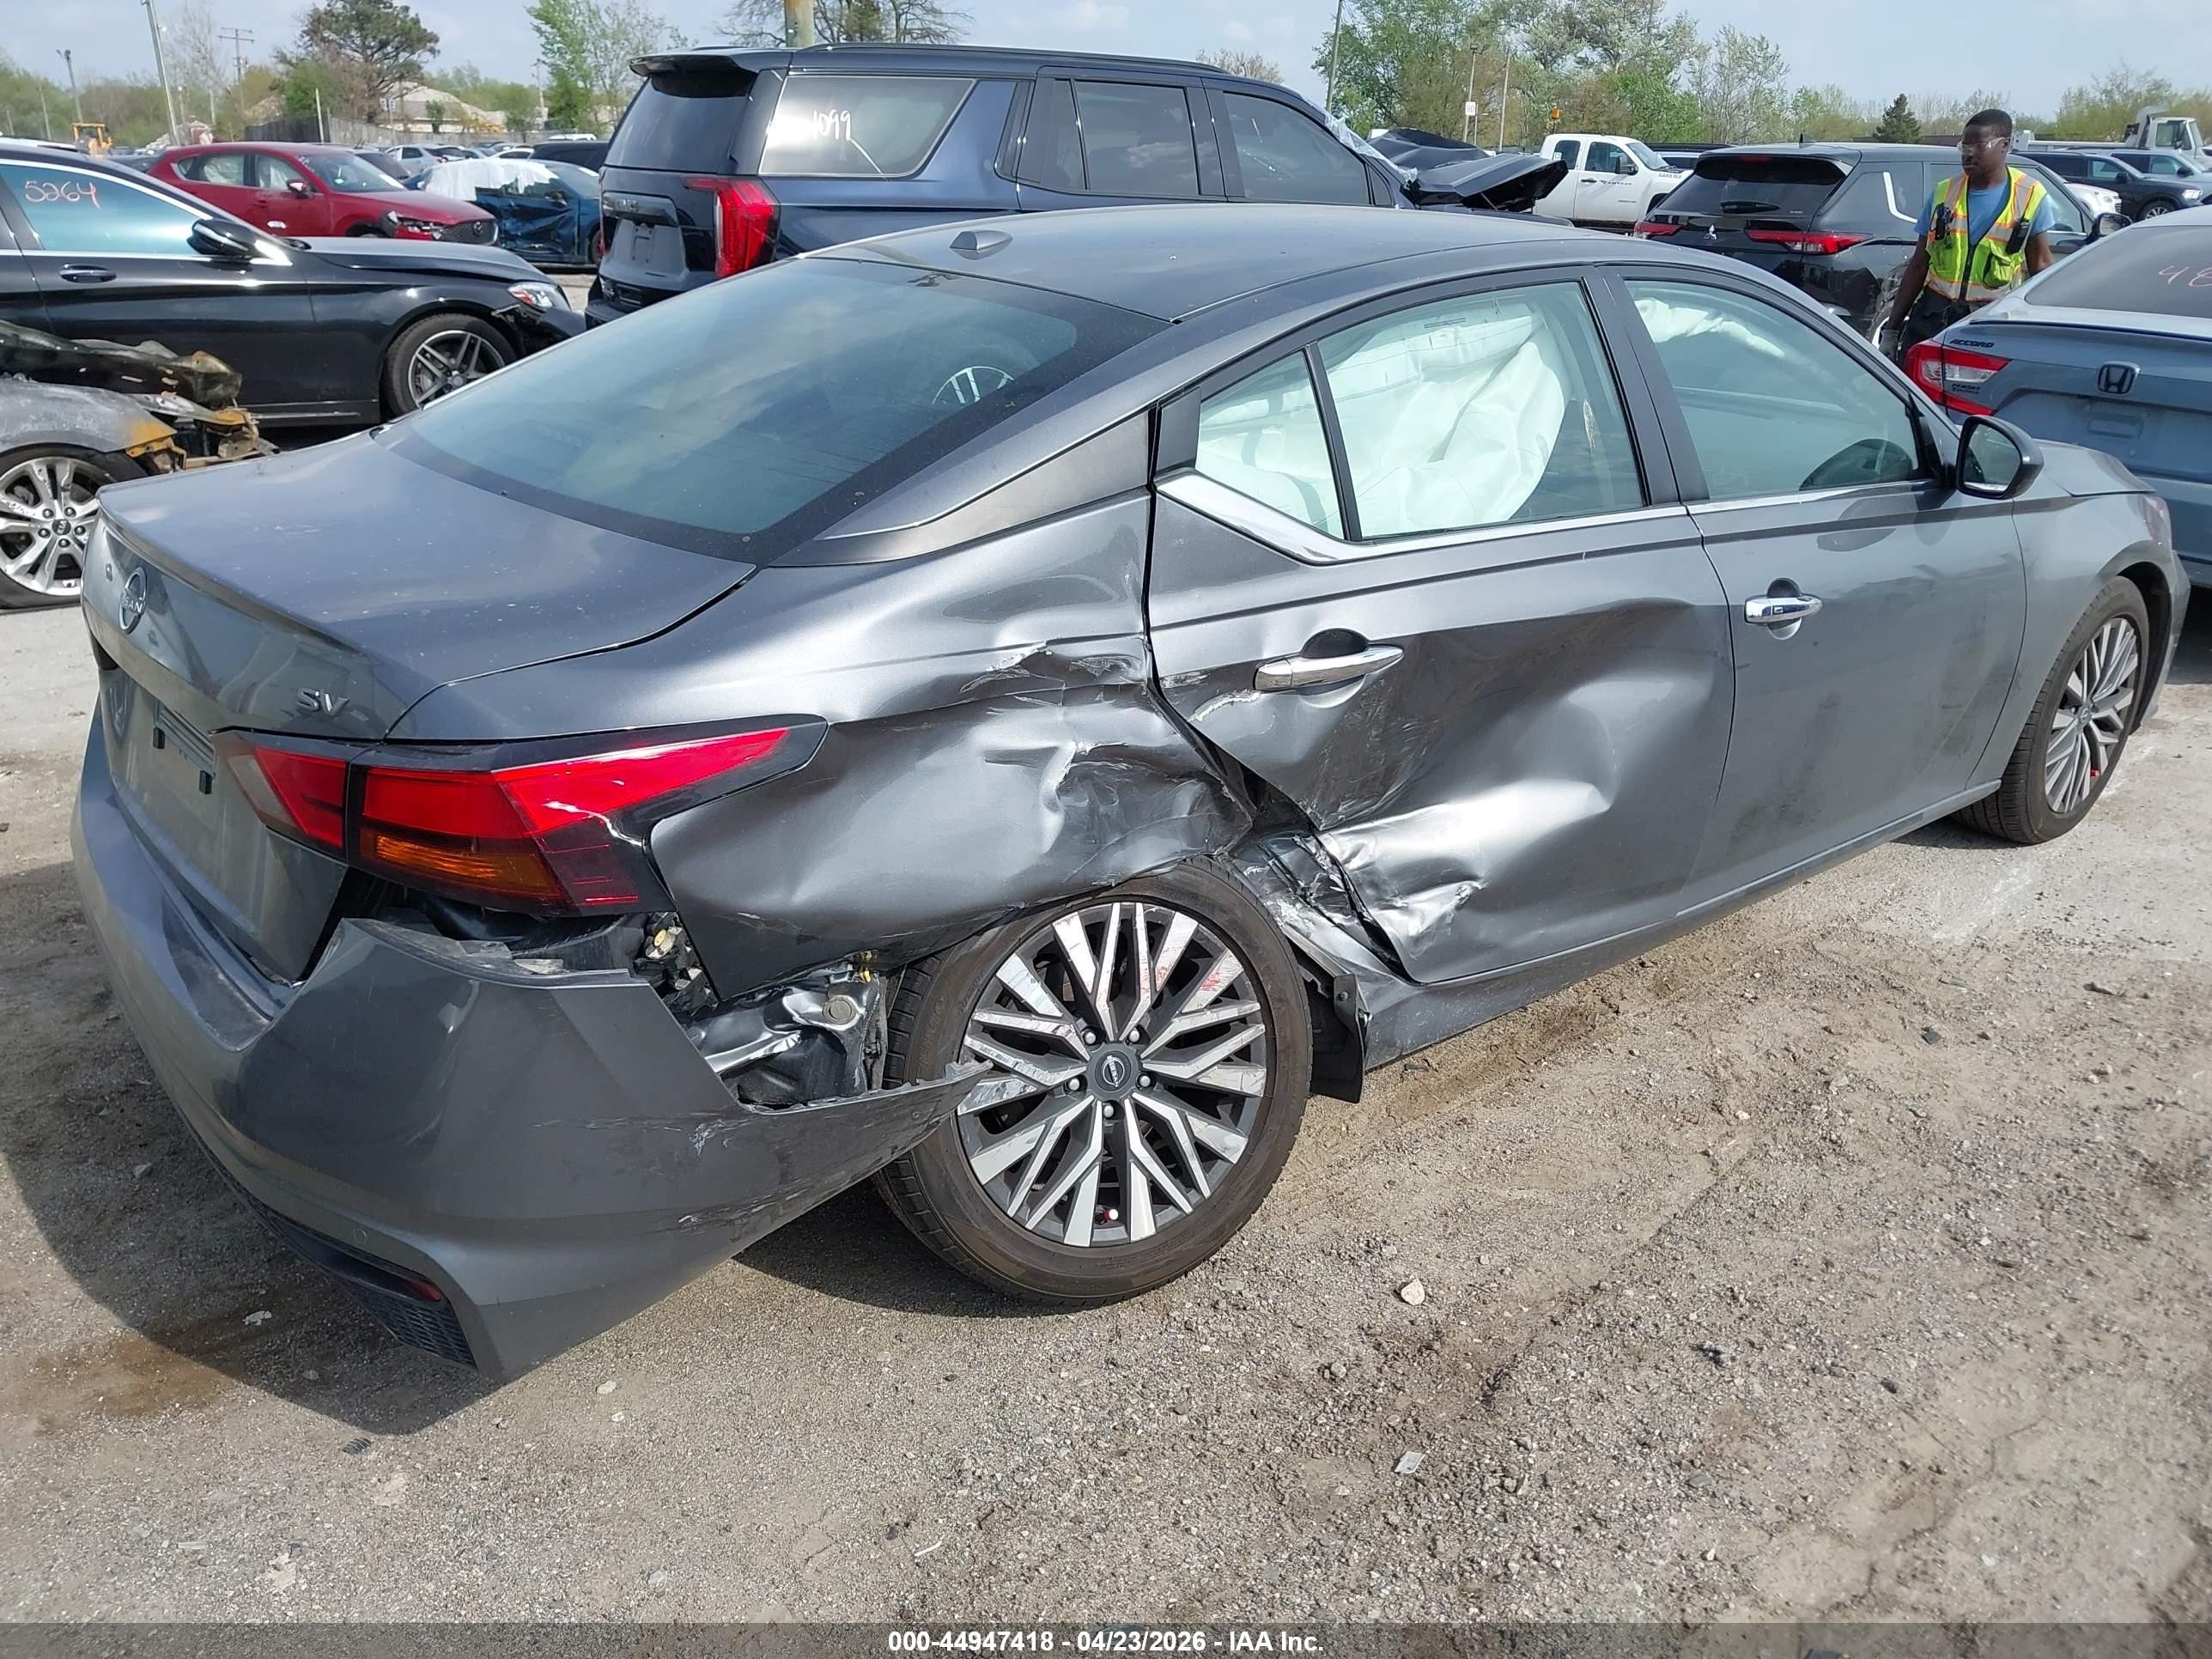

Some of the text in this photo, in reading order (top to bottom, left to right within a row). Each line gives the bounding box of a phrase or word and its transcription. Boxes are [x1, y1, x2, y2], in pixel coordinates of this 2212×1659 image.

[811, 109, 851, 141] 1099
[24, 180, 100, 209] 5264
[1949, 339, 1995, 349] ACCORD
[295, 688, 349, 717] SV
